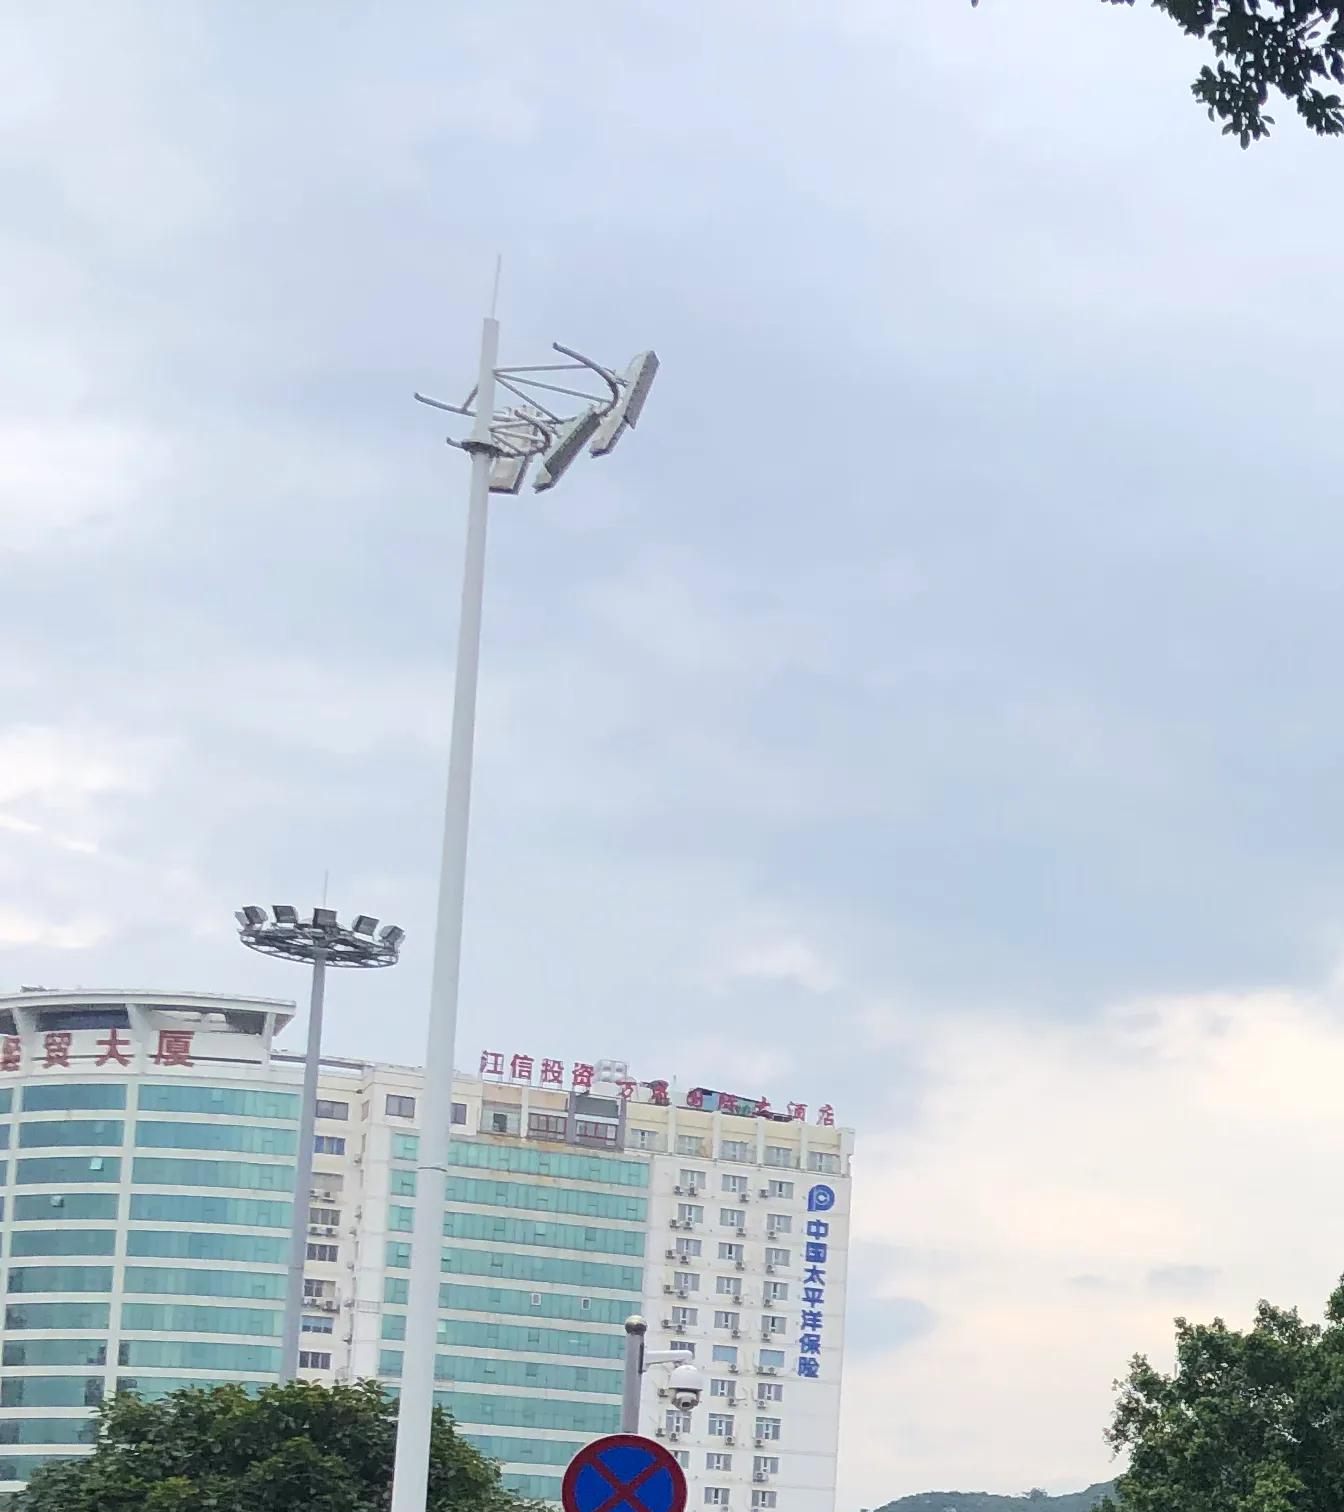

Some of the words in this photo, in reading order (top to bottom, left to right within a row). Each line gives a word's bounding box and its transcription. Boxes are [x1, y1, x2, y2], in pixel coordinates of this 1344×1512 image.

[798, 1219, 829, 1378] 中国太平洋保险
